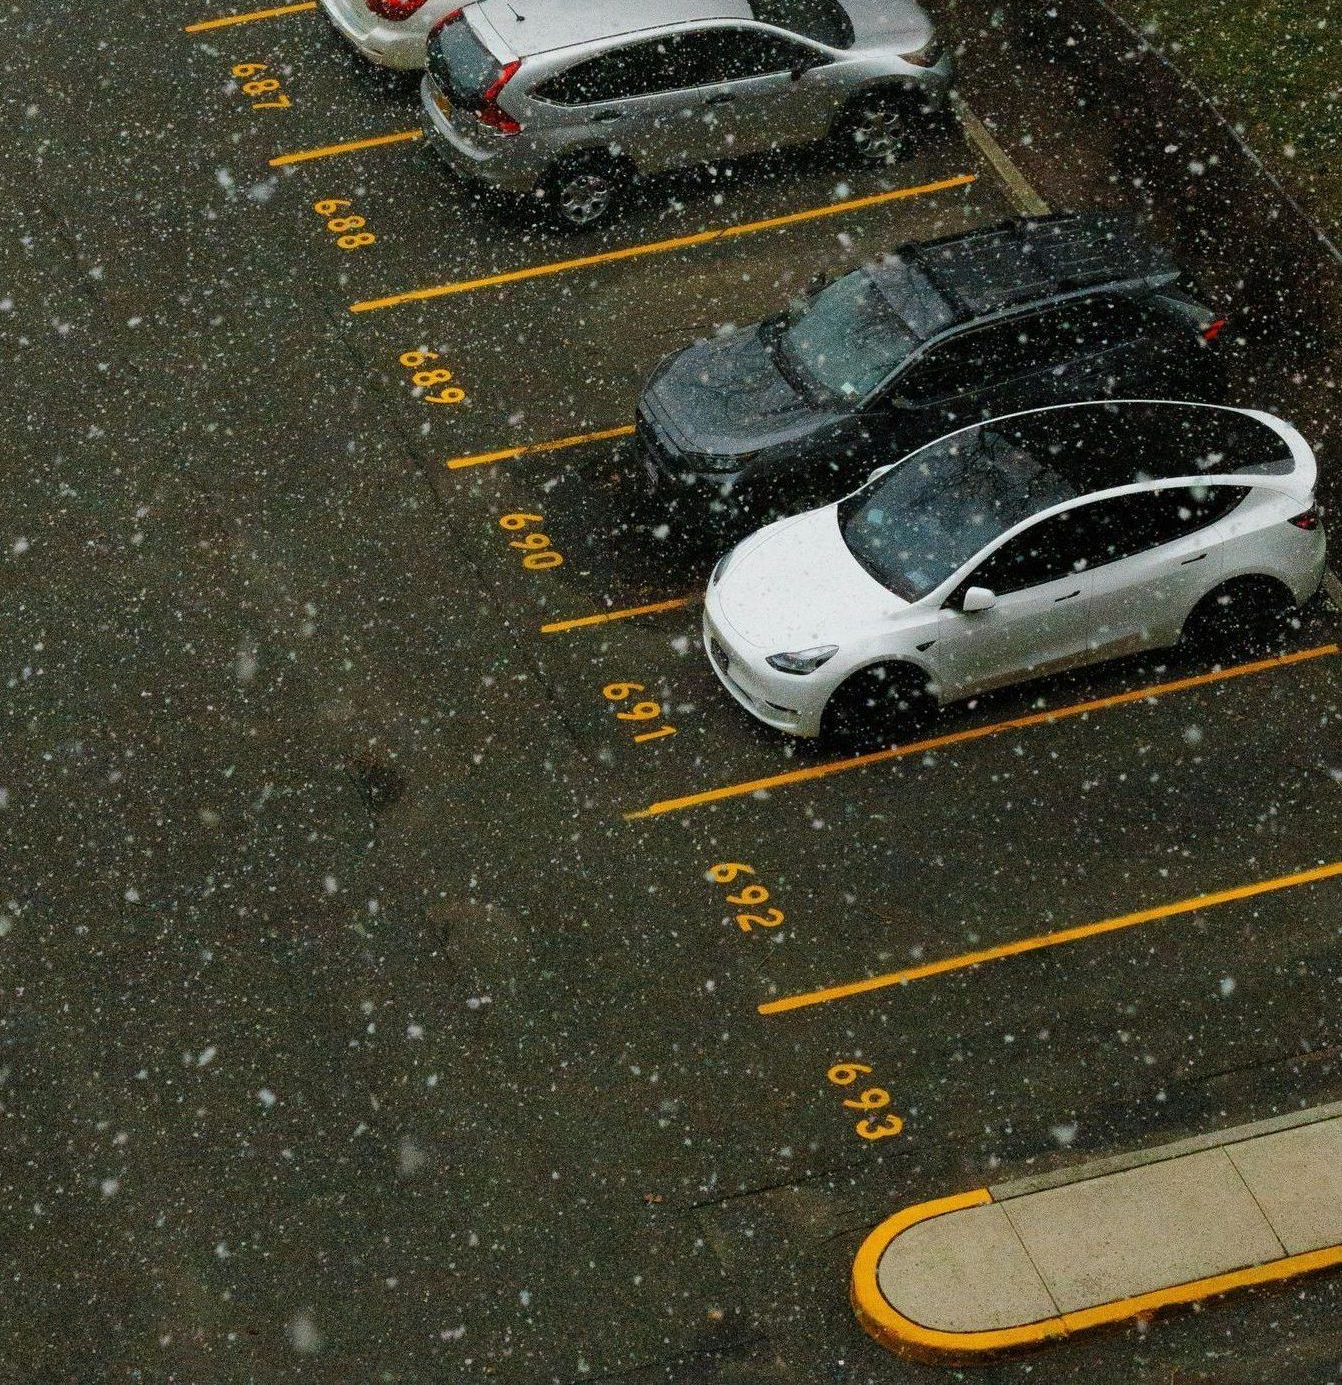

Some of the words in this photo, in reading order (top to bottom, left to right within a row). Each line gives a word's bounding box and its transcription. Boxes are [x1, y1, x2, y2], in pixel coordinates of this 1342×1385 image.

[231, 62, 291, 110] 687
[313, 198, 377, 251] 688
[399, 350, 466, 405] 689
[499, 510, 564, 570] 690
[602, 681, 676, 743] 691
[709, 862, 784, 932] 692
[826, 1061, 903, 1140] 693
